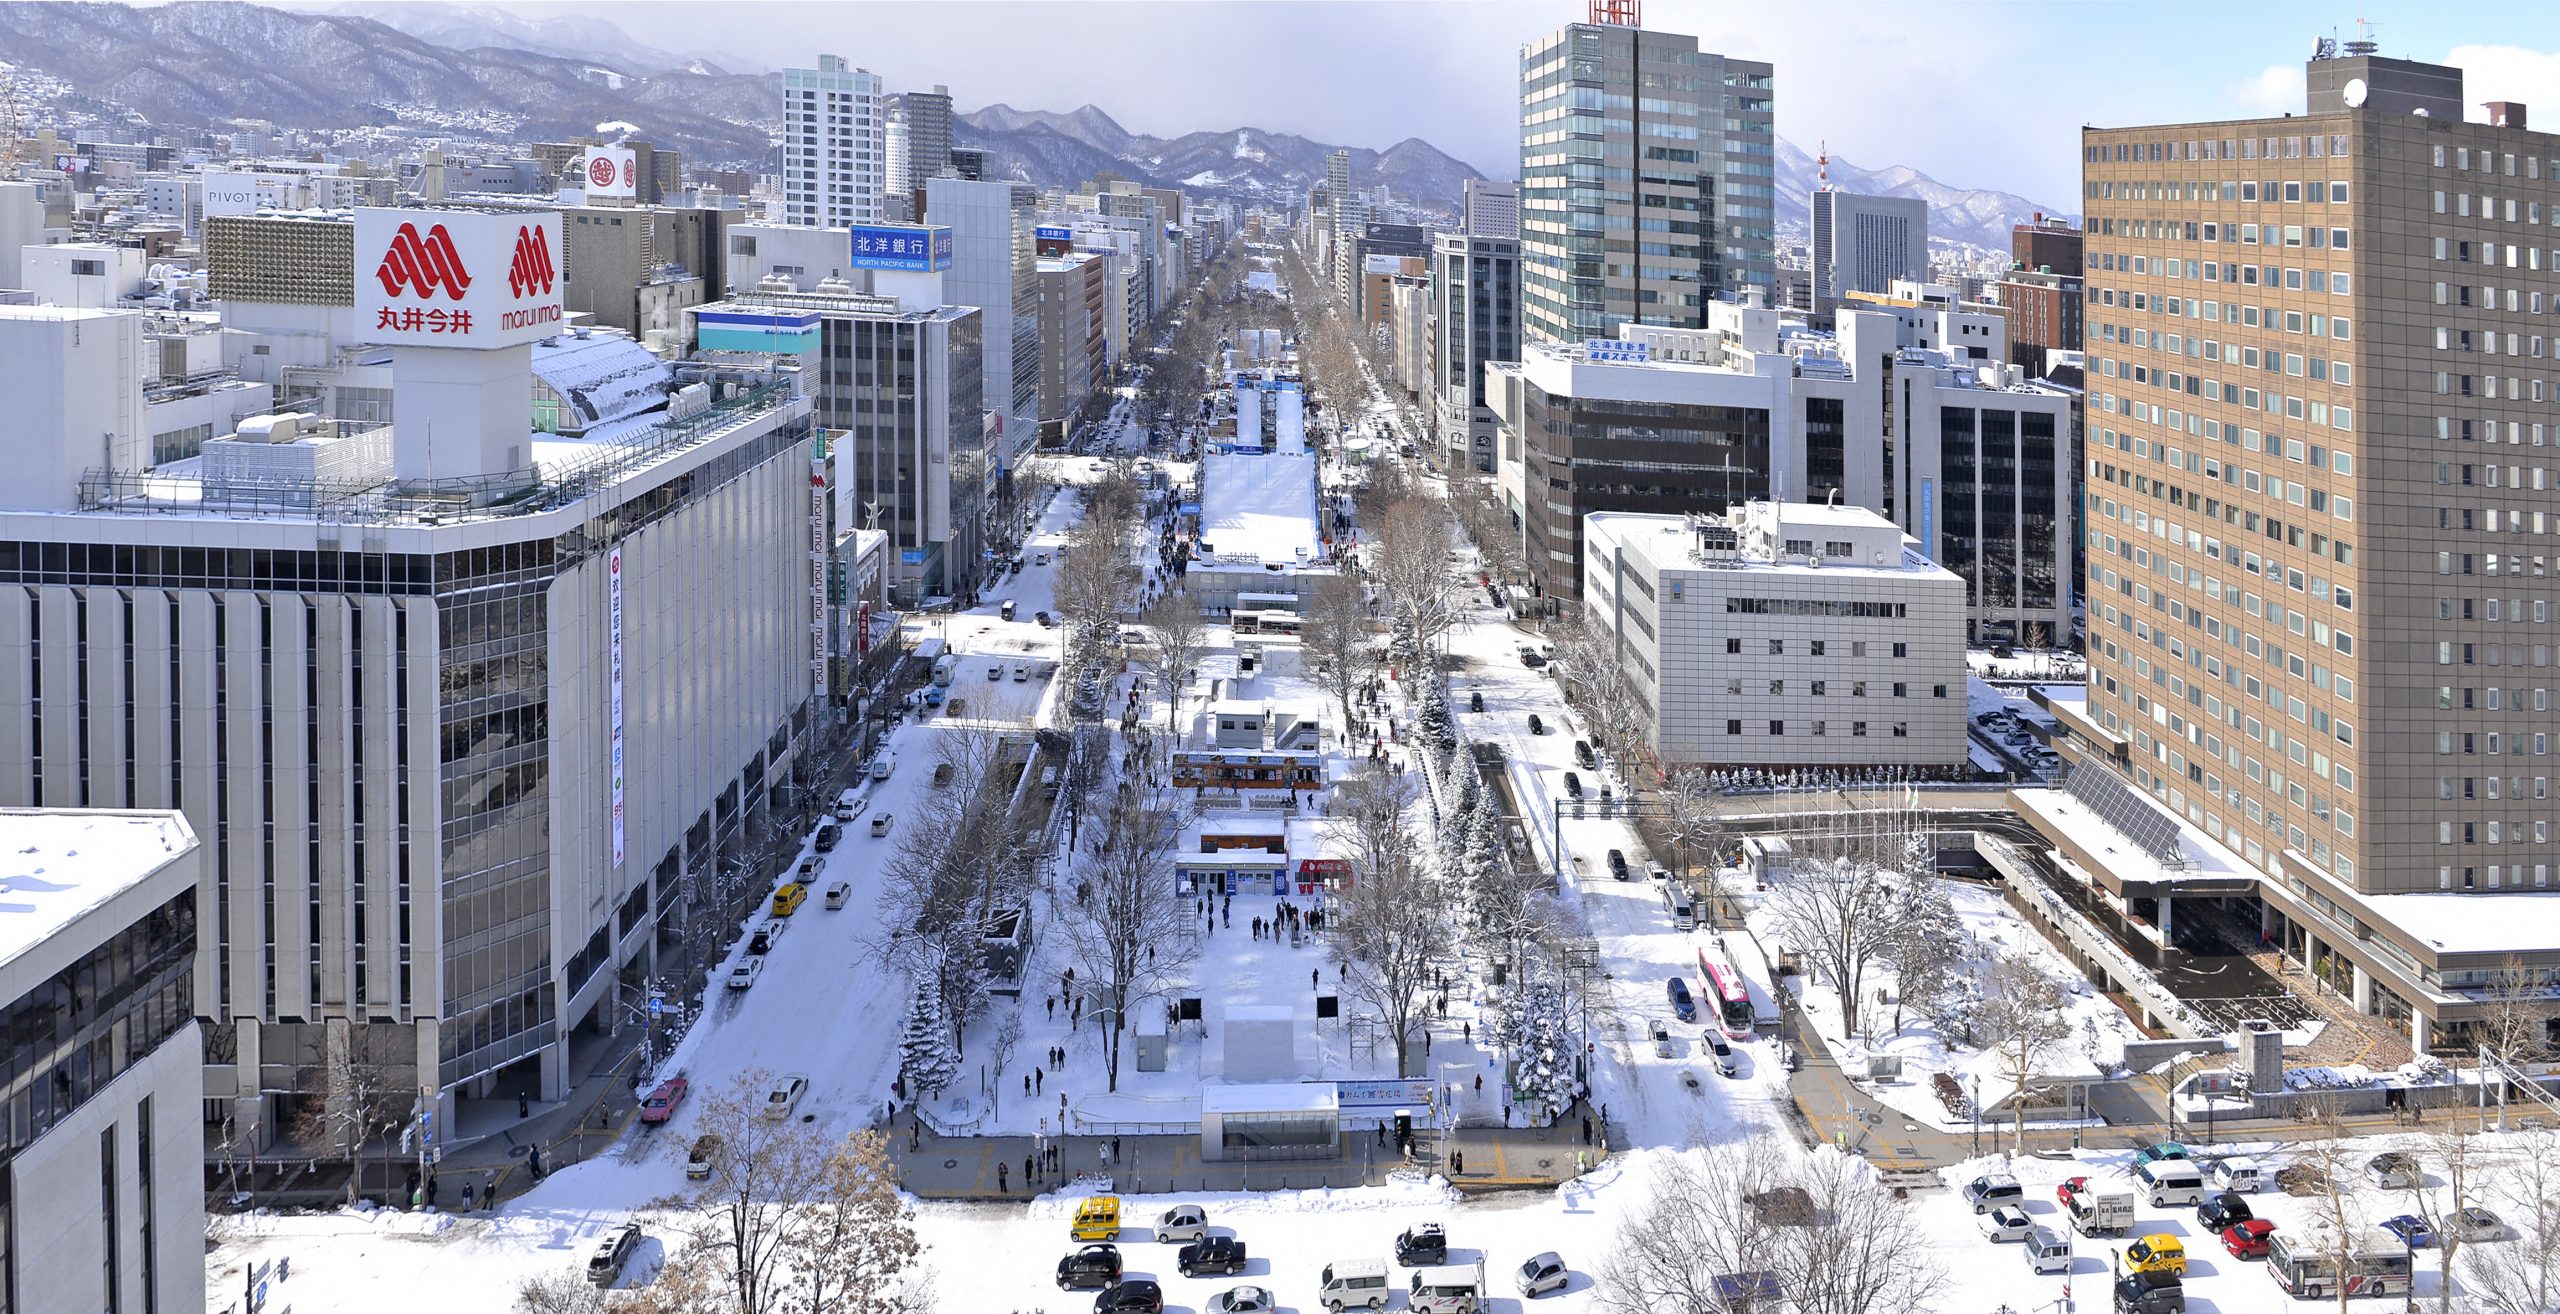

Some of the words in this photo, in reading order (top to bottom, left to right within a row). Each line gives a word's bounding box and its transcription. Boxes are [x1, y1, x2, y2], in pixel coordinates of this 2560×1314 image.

[209, 191, 252, 204] PIVOT
[857, 236, 924, 254] 北洋銀行
[857, 259, 879, 267] NORTH
[880, 260, 905, 268] PACIFIC
[906, 261, 924, 269] BANK
[377, 306, 473, 334] 丸井今井
[1590, 340, 1646, 351] 北海道新聞
[1590, 352, 1646, 362] 道新スポーツ
